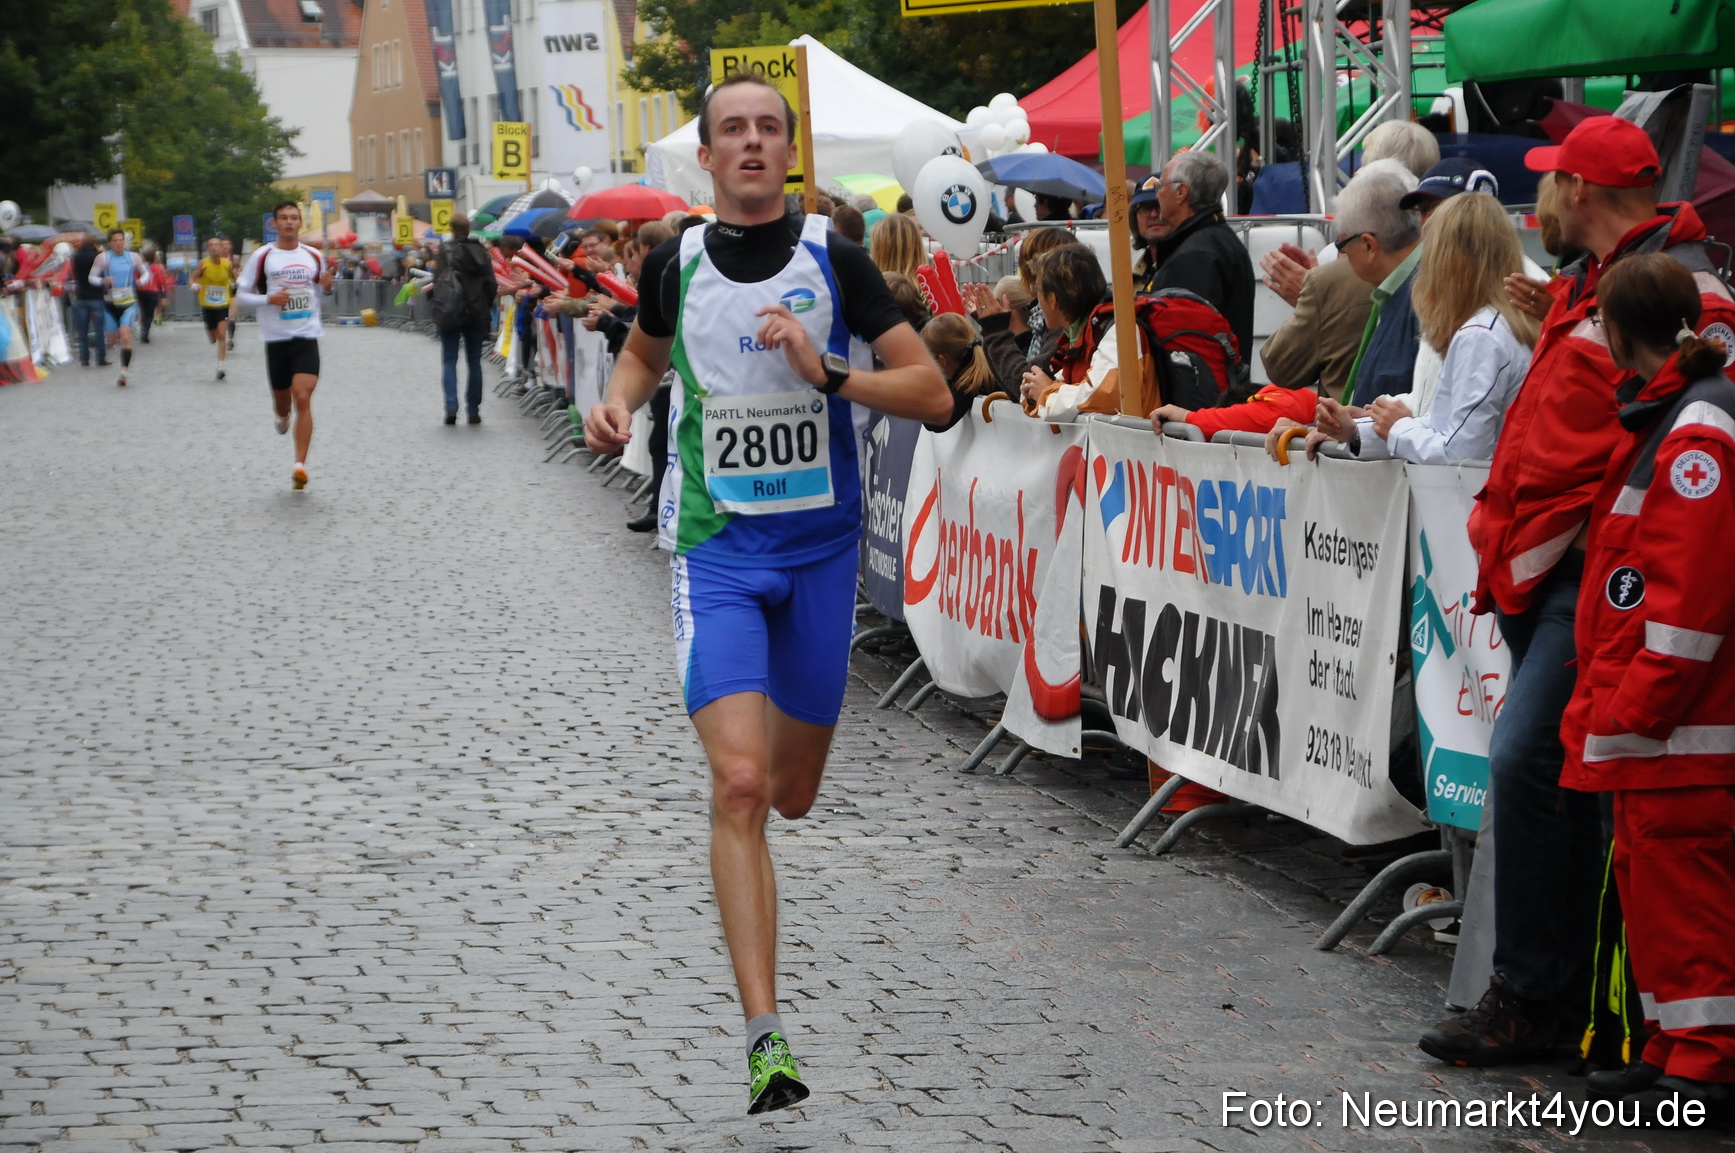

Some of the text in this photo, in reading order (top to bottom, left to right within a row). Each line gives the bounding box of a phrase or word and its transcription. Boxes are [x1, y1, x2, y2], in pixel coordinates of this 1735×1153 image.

[497, 124, 527, 135] Block
[503, 140, 521, 168] B
[98, 211, 110, 229] C
[436, 209, 449, 226] C
[399, 225, 409, 238] D
[705, 408, 744, 420] PARTL
[747, 404, 806, 419] Neumarkt
[716, 419, 818, 469] 2800
[709, 467, 715, 475] A
[1676, 453, 1716, 472] DEUTSCHES
[753, 478, 787, 497] Rolf
[1122, 458, 1288, 599] INTERSPORT
[1306, 596, 1324, 637] Im
[1308, 649, 1330, 690] der
[1094, 583, 1281, 781] HCKNER
[1305, 724, 1342, 772] 92318
[1433, 773, 1488, 807] Service
